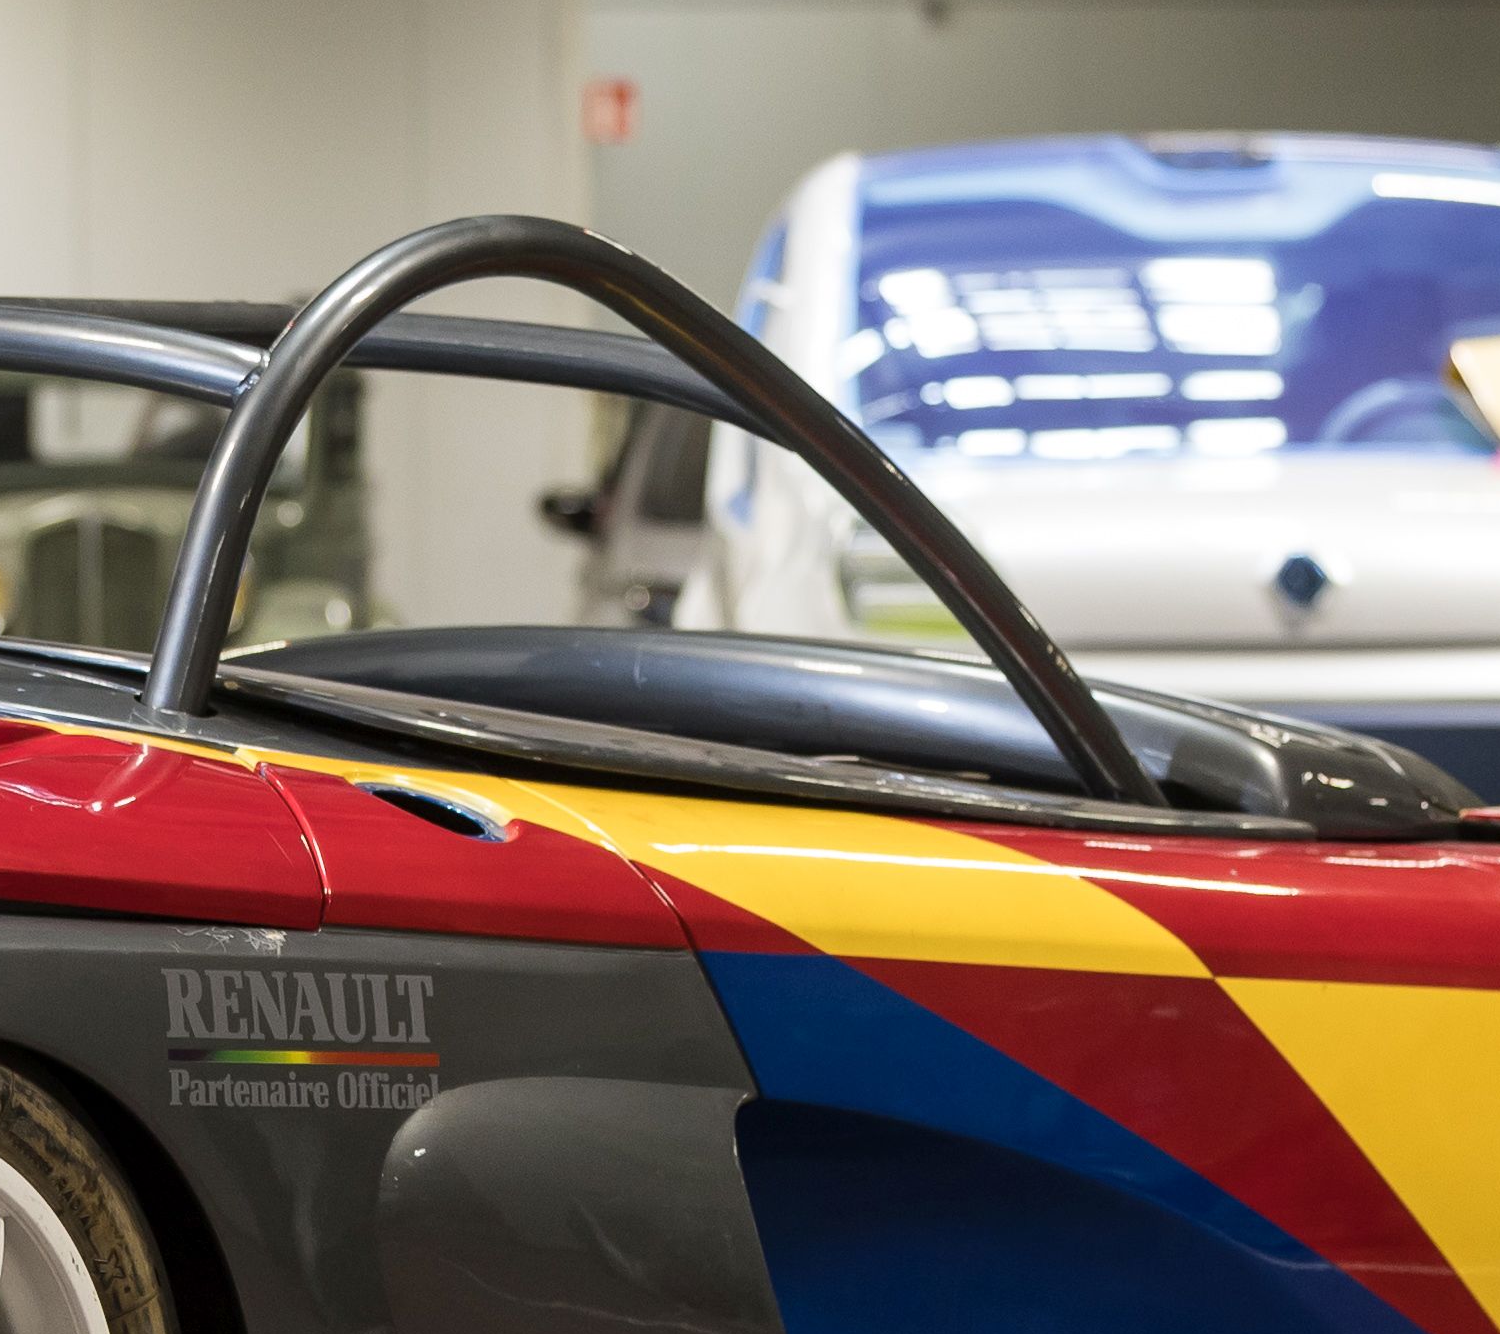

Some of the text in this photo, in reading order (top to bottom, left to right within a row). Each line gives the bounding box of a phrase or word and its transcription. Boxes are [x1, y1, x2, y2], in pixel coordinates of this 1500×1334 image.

[161, 967, 434, 1043] RENAULT
[168, 1069, 440, 1109] Partenaire Officiel
